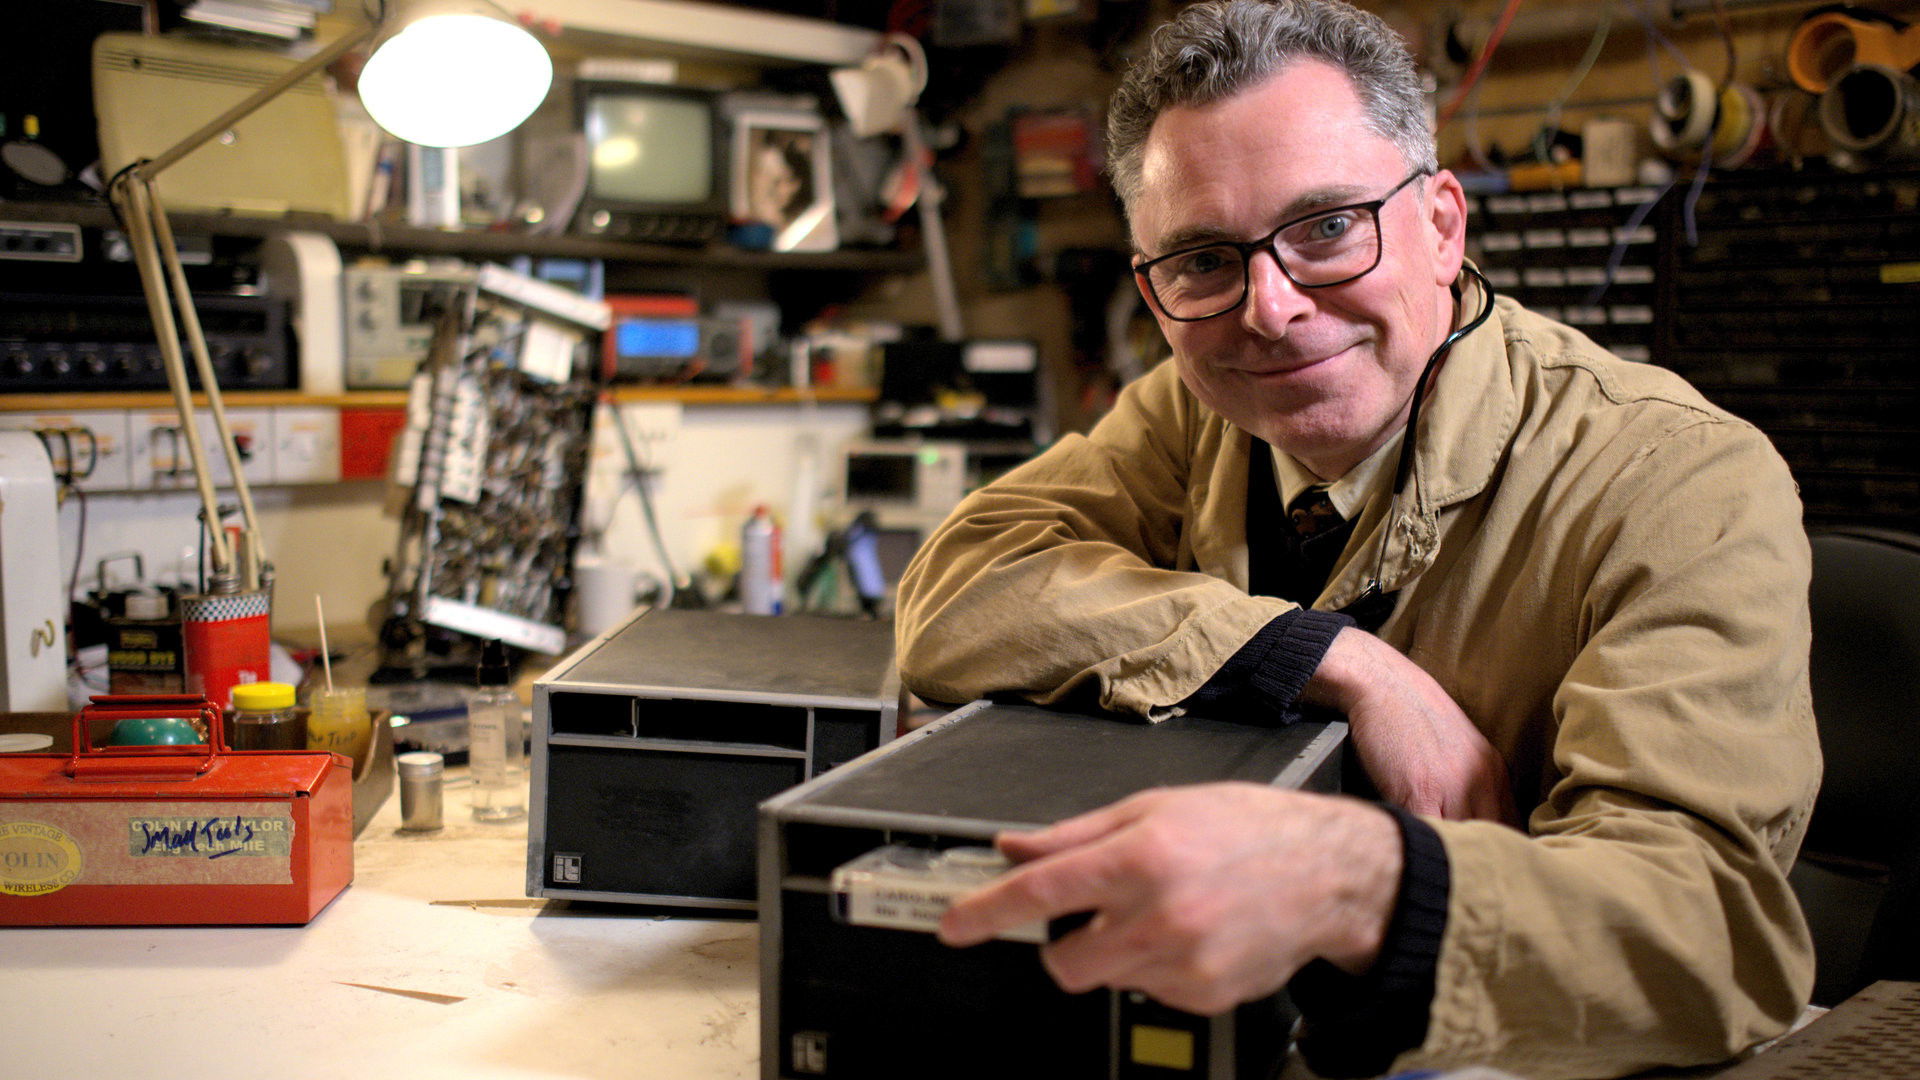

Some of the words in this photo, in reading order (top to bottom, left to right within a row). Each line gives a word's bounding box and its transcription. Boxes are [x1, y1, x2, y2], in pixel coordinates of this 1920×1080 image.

[12, 824, 63, 842] VINTAGE
[0, 851, 58, 868] OLIN
[3, 879, 60, 893] WIRELESS
